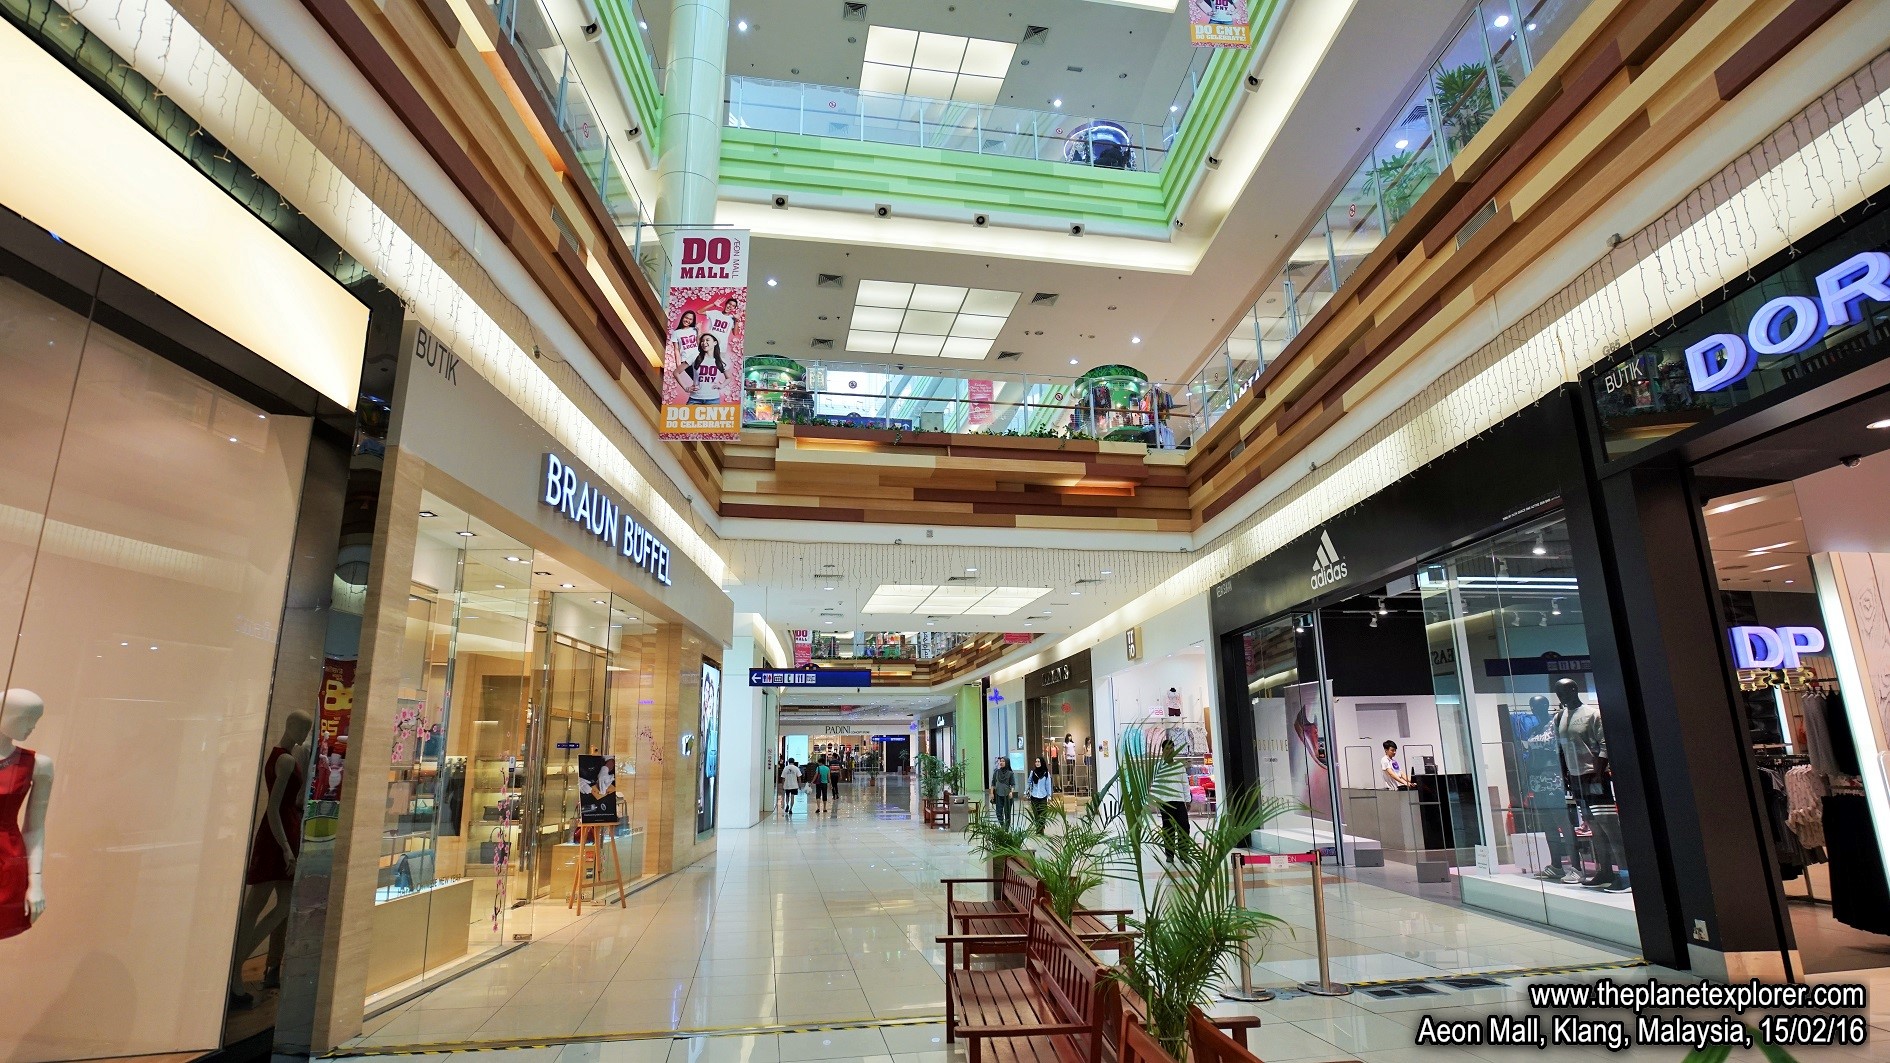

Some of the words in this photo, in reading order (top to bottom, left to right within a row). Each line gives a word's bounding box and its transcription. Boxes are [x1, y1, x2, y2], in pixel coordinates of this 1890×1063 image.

[1195, 25, 1212, 35] DO
[1216, 25, 1246, 37] CNY!
[681, 237, 732, 265] DO
[680, 266, 730, 279] MALL
[416, 327, 460, 386] BUTIK
[699, 364, 718, 377] DO
[1605, 358, 1643, 394] BUTIK
[698, 375, 717, 384] CNY
[666, 406, 690, 421] DO
[695, 406, 736, 421] CNY!
[665, 420, 679, 428] DO
[680, 420, 735, 429] CELEBRATE!
[544, 453, 619, 547] BRAUN
[1310, 562, 1349, 590] adidas
[1732, 625, 1825, 669] DP
[825, 725, 851, 734] PADINI
